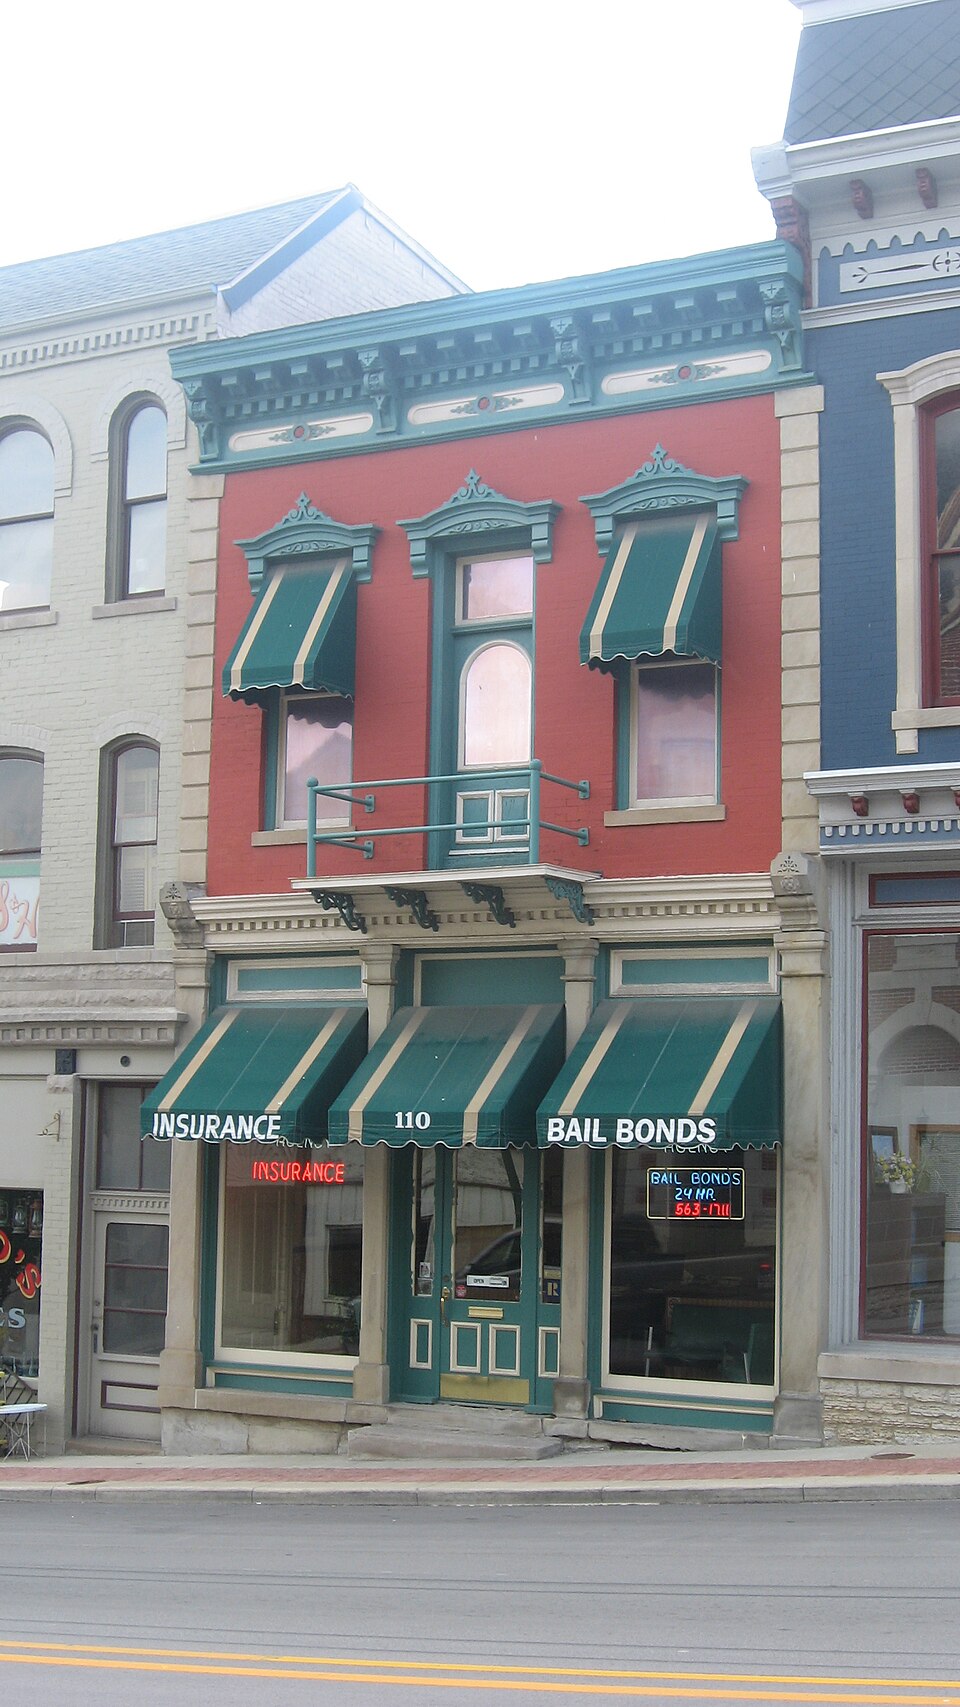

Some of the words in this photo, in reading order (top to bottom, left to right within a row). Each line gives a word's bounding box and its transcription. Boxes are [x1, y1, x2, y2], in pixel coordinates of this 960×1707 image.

[152, 1113, 281, 1140] INSURANCE
[395, 1111, 431, 1130] 110
[547, 1118, 607, 1142] BAIL
[616, 1118, 716, 1143] BONDS
[252, 1161, 345, 1184] INSURANCE
[650, 1172, 682, 1185] BAIL
[691, 1172, 741, 1185] BONDS
[674, 1187, 693, 1200] 24
[674, 1203, 731, 1217] 563-1711
